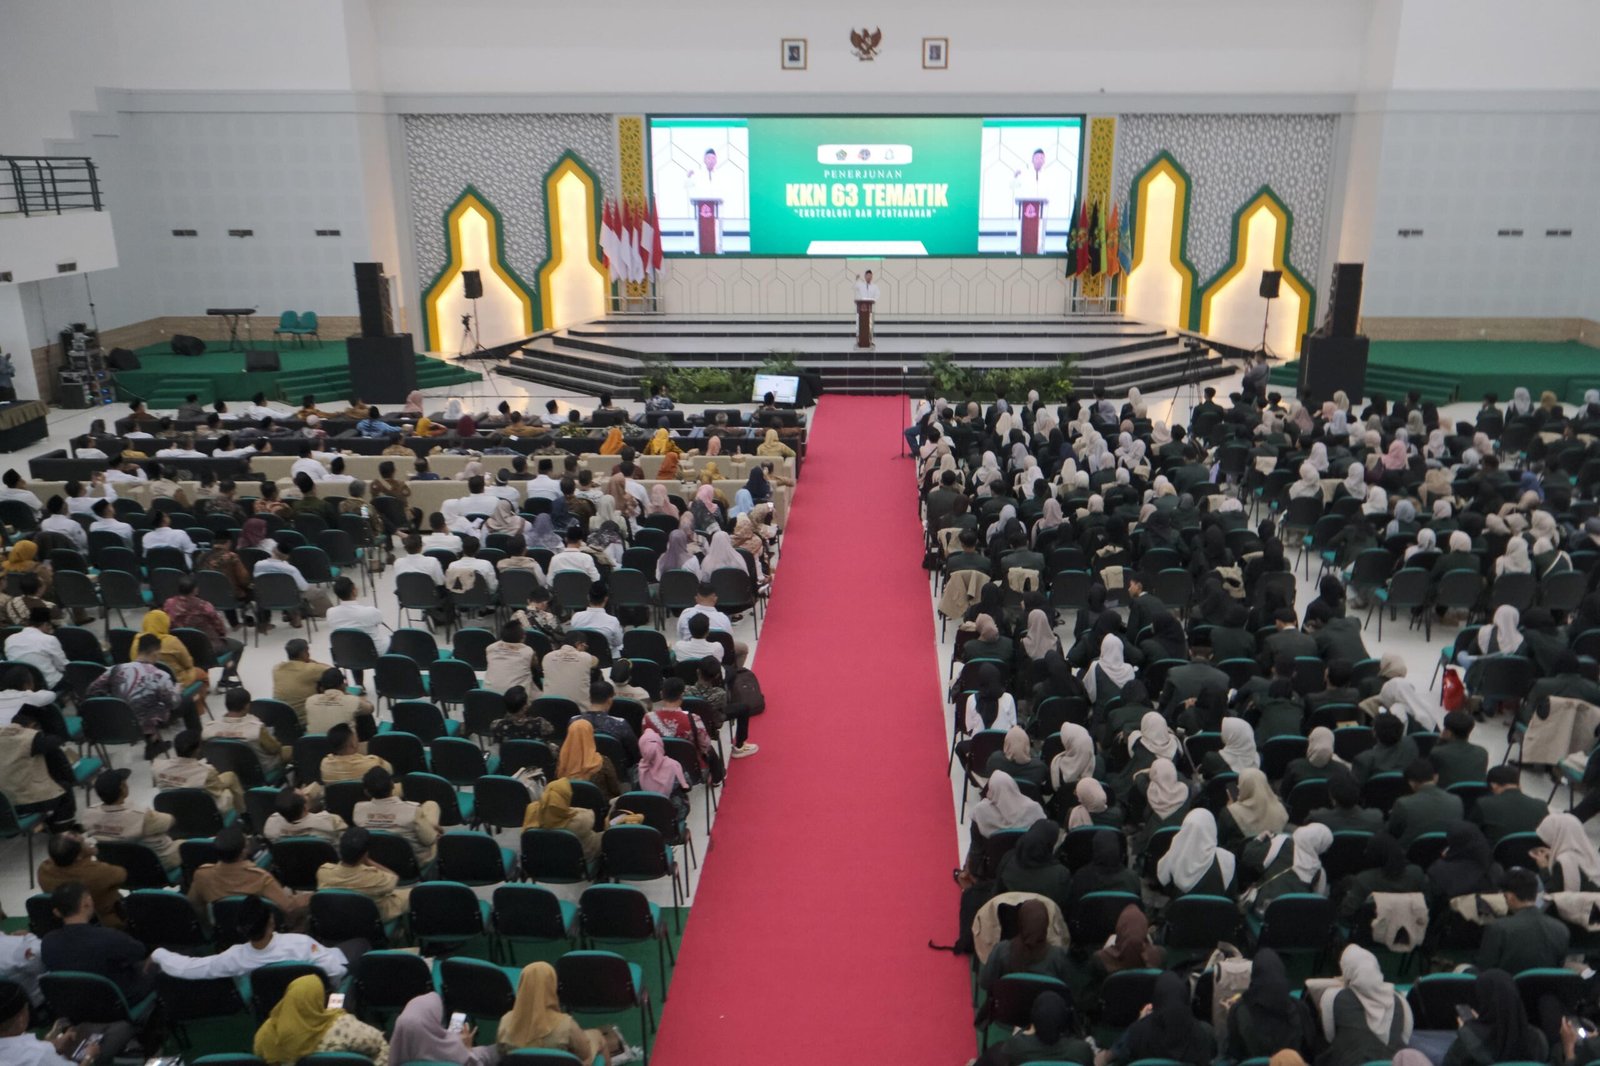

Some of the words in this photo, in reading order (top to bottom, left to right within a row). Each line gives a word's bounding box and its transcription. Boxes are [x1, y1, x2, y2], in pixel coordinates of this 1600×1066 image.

[823, 169, 903, 179] PENERJUNAN
[785, 183, 827, 207] KKN
[831, 182, 859, 207] 63
[862, 183, 949, 207] TEMATIK
[855, 208, 872, 218] DAN
